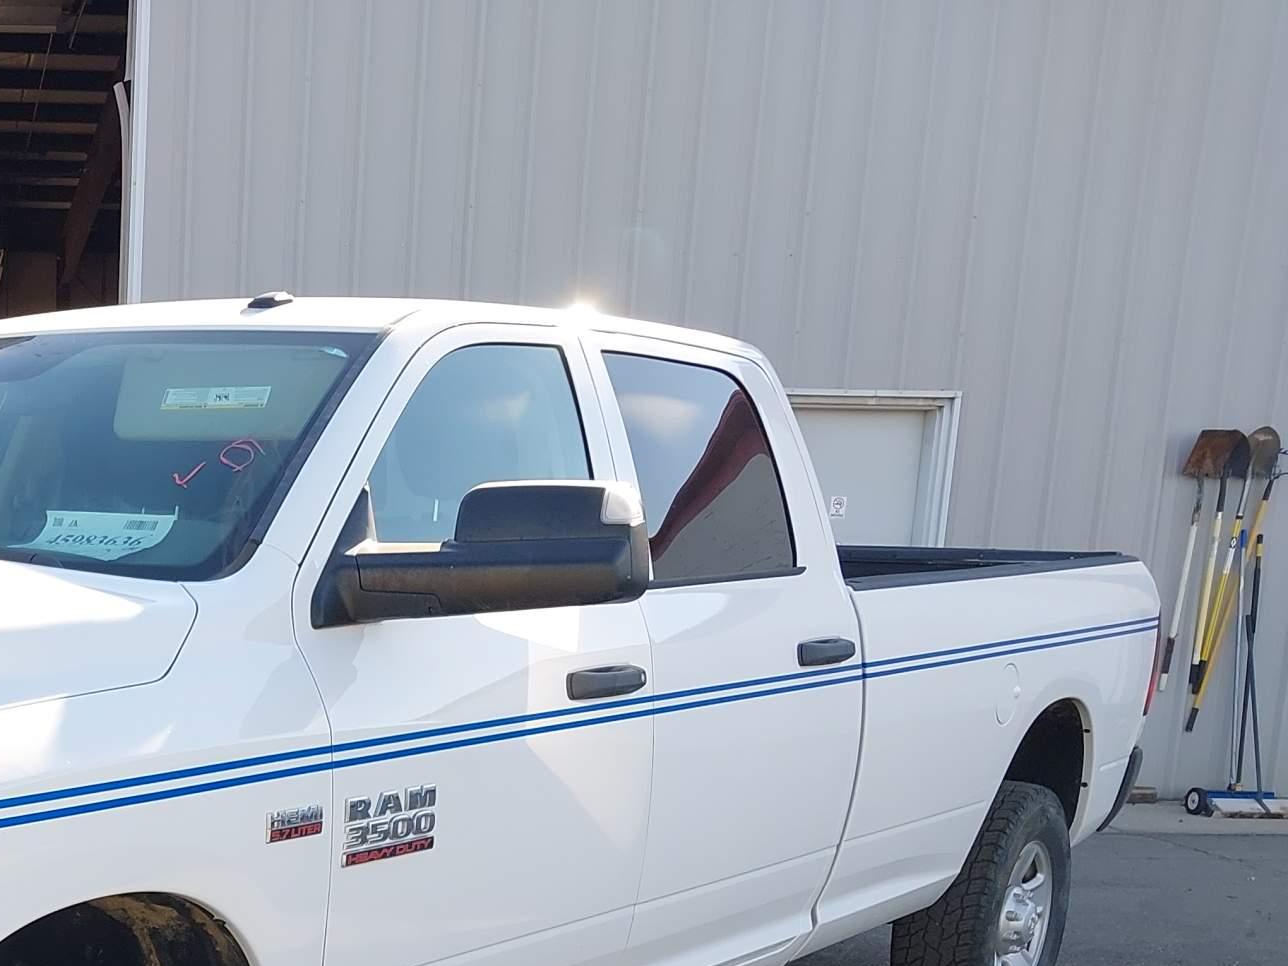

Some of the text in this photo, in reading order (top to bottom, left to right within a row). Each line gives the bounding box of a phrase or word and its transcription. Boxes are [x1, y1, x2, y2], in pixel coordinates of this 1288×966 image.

[344, 783, 436, 823] RAM
[266, 805, 323, 829] HEMI
[291, 822, 321, 838] LITER
[343, 810, 436, 850] 3500
[348, 839, 431, 865] HEAVY DUTY
